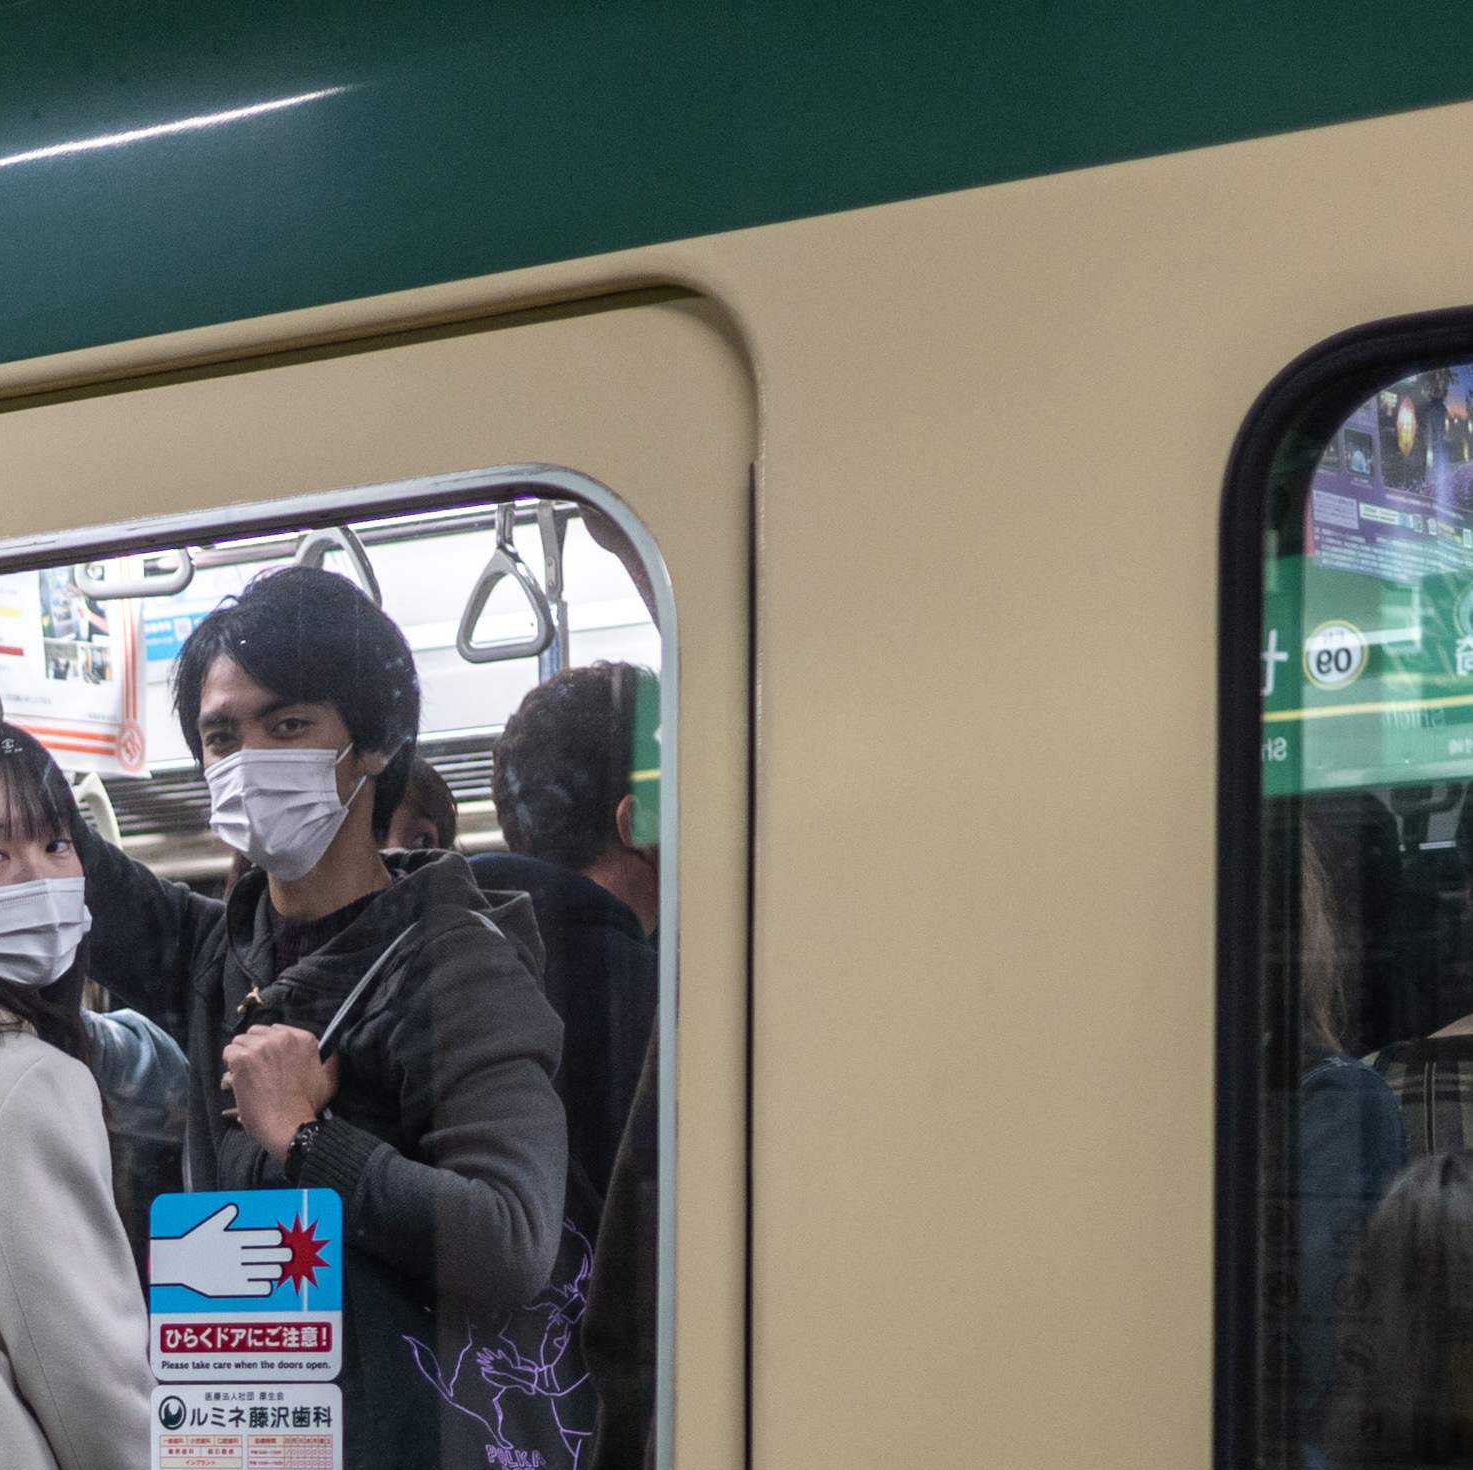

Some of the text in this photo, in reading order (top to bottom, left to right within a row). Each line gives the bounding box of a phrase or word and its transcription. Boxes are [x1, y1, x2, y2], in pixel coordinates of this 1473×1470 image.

[165, 1326, 328, 1349] ひらくドアにご注意!
[161, 1359, 332, 1372] Please take care when the doors open.
[189, 1406, 333, 1429] ルミネ藤沢歯科
[485, 1444, 547, 1468] POLKA
